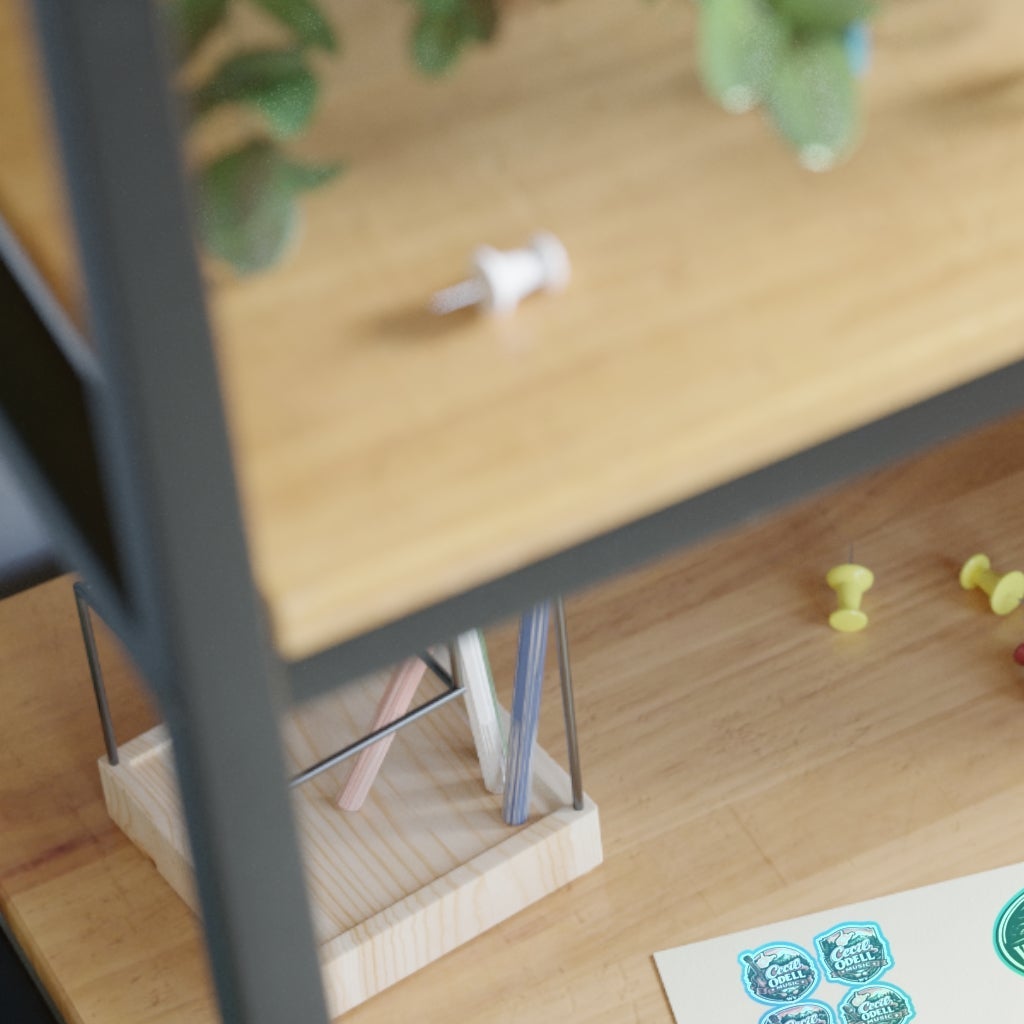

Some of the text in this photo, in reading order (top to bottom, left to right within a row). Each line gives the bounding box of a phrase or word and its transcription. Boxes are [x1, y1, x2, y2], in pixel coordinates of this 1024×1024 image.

[834, 951, 876, 970] ODELL
[845, 962, 870, 972] MUSIC
[768, 970, 806, 988] ODELL
[776, 981, 800, 990] MUSIC
[861, 1006, 894, 1021] ODELL
[867, 1015, 892, 1024] MUSIC
